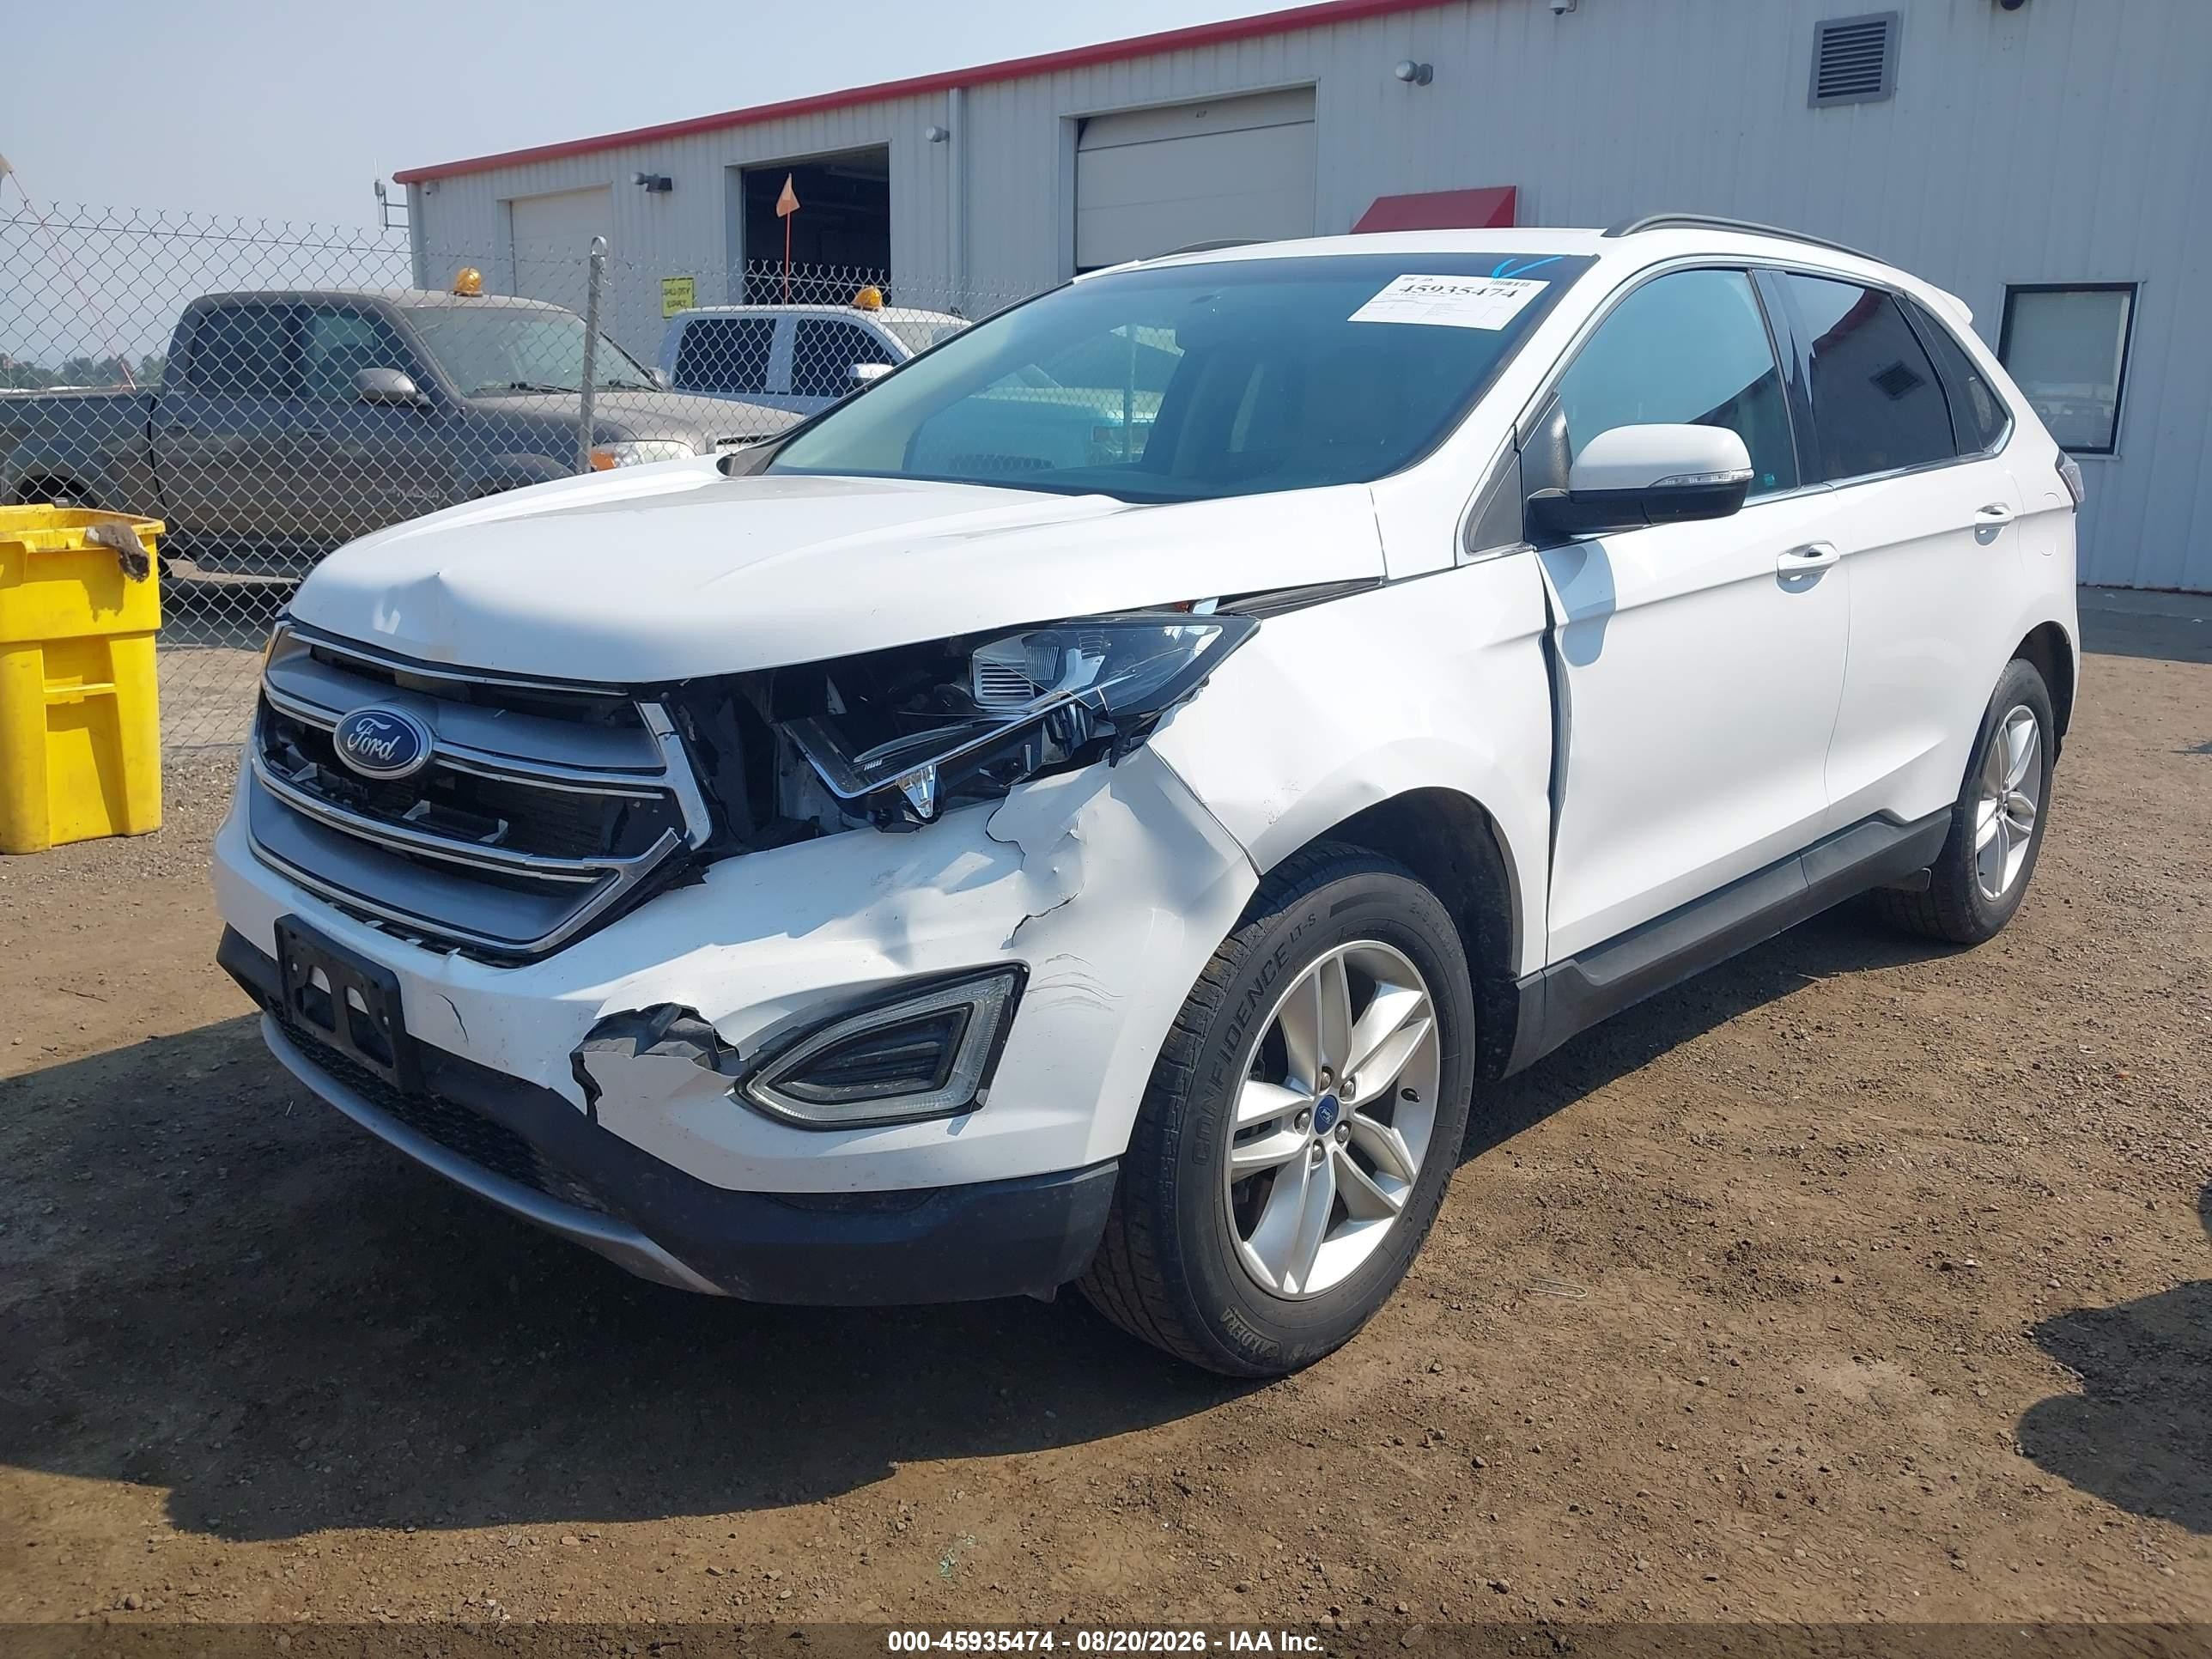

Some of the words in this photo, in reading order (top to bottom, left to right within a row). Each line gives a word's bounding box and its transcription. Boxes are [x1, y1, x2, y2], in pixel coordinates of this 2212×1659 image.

[1399, 284, 1519, 298] 45935474
[347, 718, 401, 760] Ford
[1194, 942, 1290, 1164] CONFIDENCE
